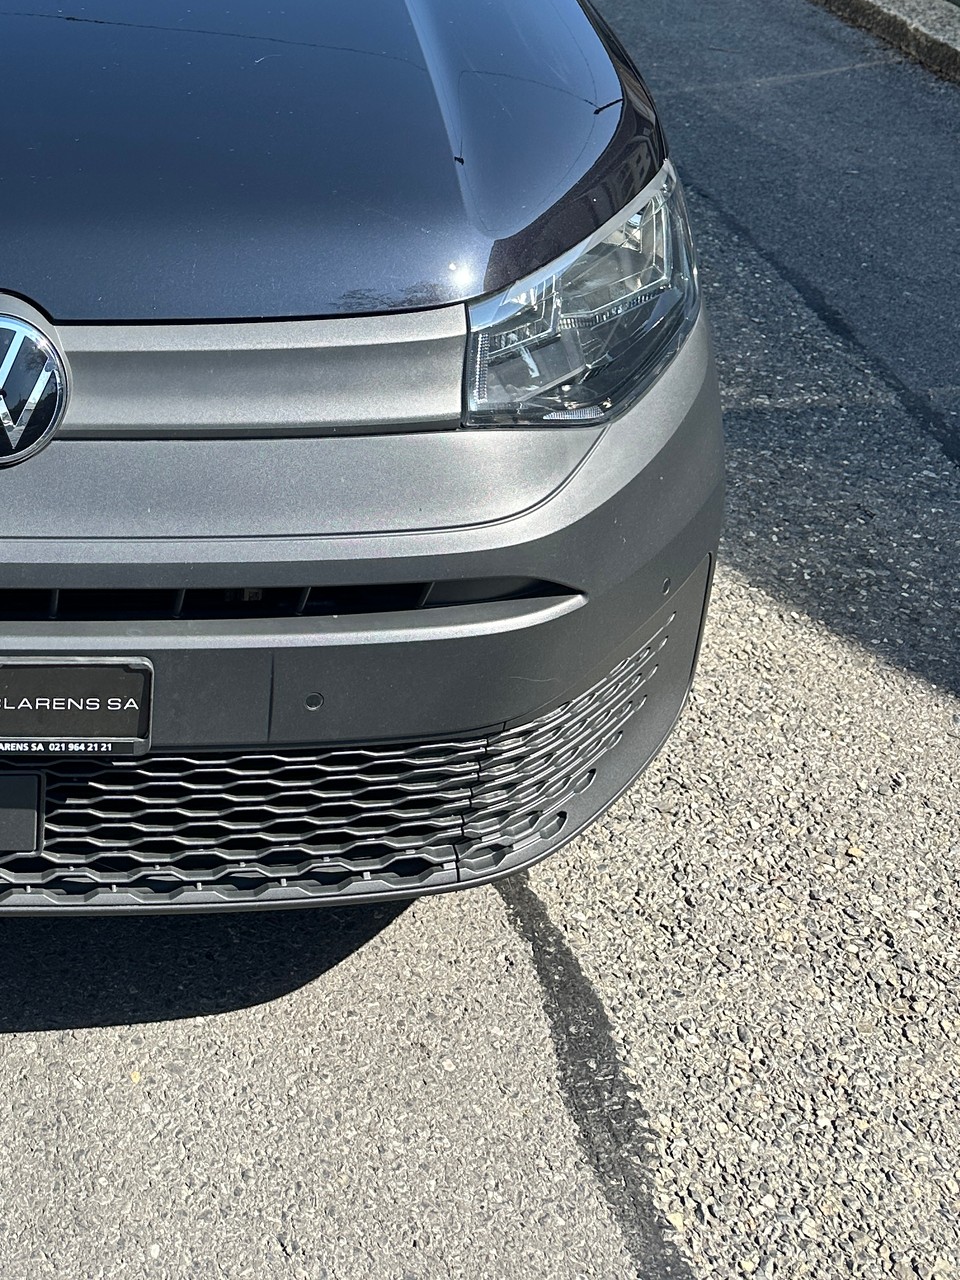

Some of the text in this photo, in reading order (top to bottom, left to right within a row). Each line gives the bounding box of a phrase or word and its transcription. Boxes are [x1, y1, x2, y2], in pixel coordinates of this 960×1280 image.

[107, 697, 140, 711] SA
[31, 742, 45, 751] SA
[48, 742, 66, 752] 021
[68, 742, 85, 752] 964
[87, 742, 98, 752] 21
[101, 742, 112, 752] 21
